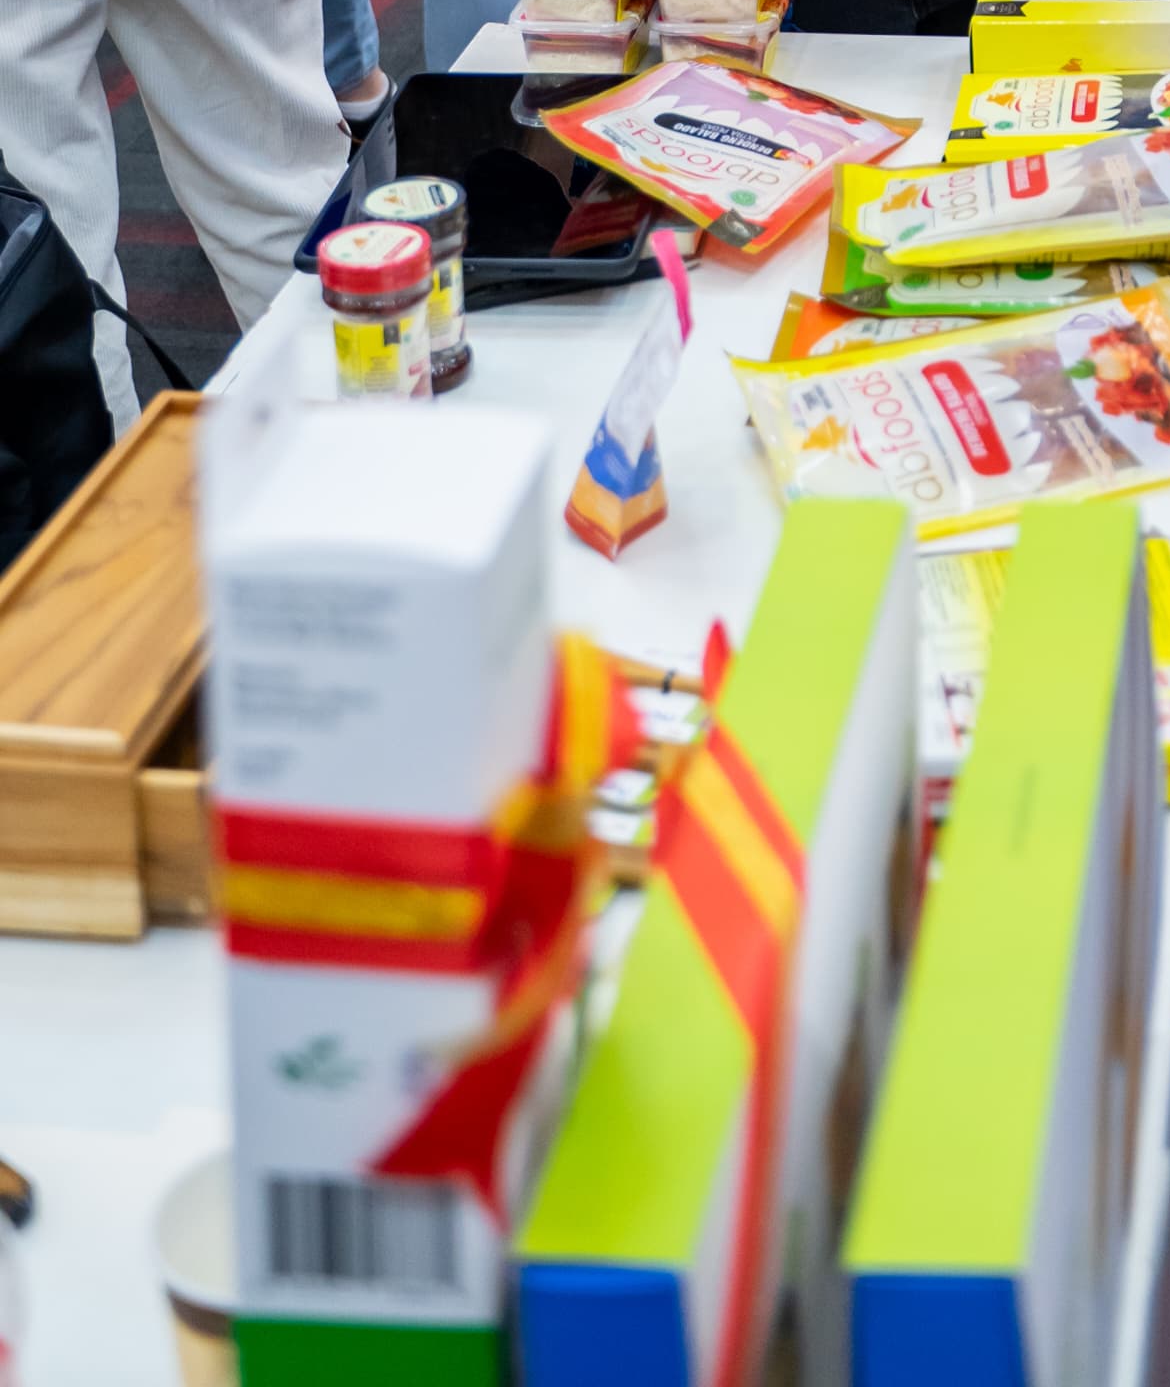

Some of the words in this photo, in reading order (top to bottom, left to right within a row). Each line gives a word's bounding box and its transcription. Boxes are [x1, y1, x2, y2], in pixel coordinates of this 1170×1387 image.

[626, 118, 780, 186] dbfoods
[673, 122, 720, 141] BALADO
[719, 134, 773, 155] DENDENG
[855, 370, 944, 502] dbfoods
